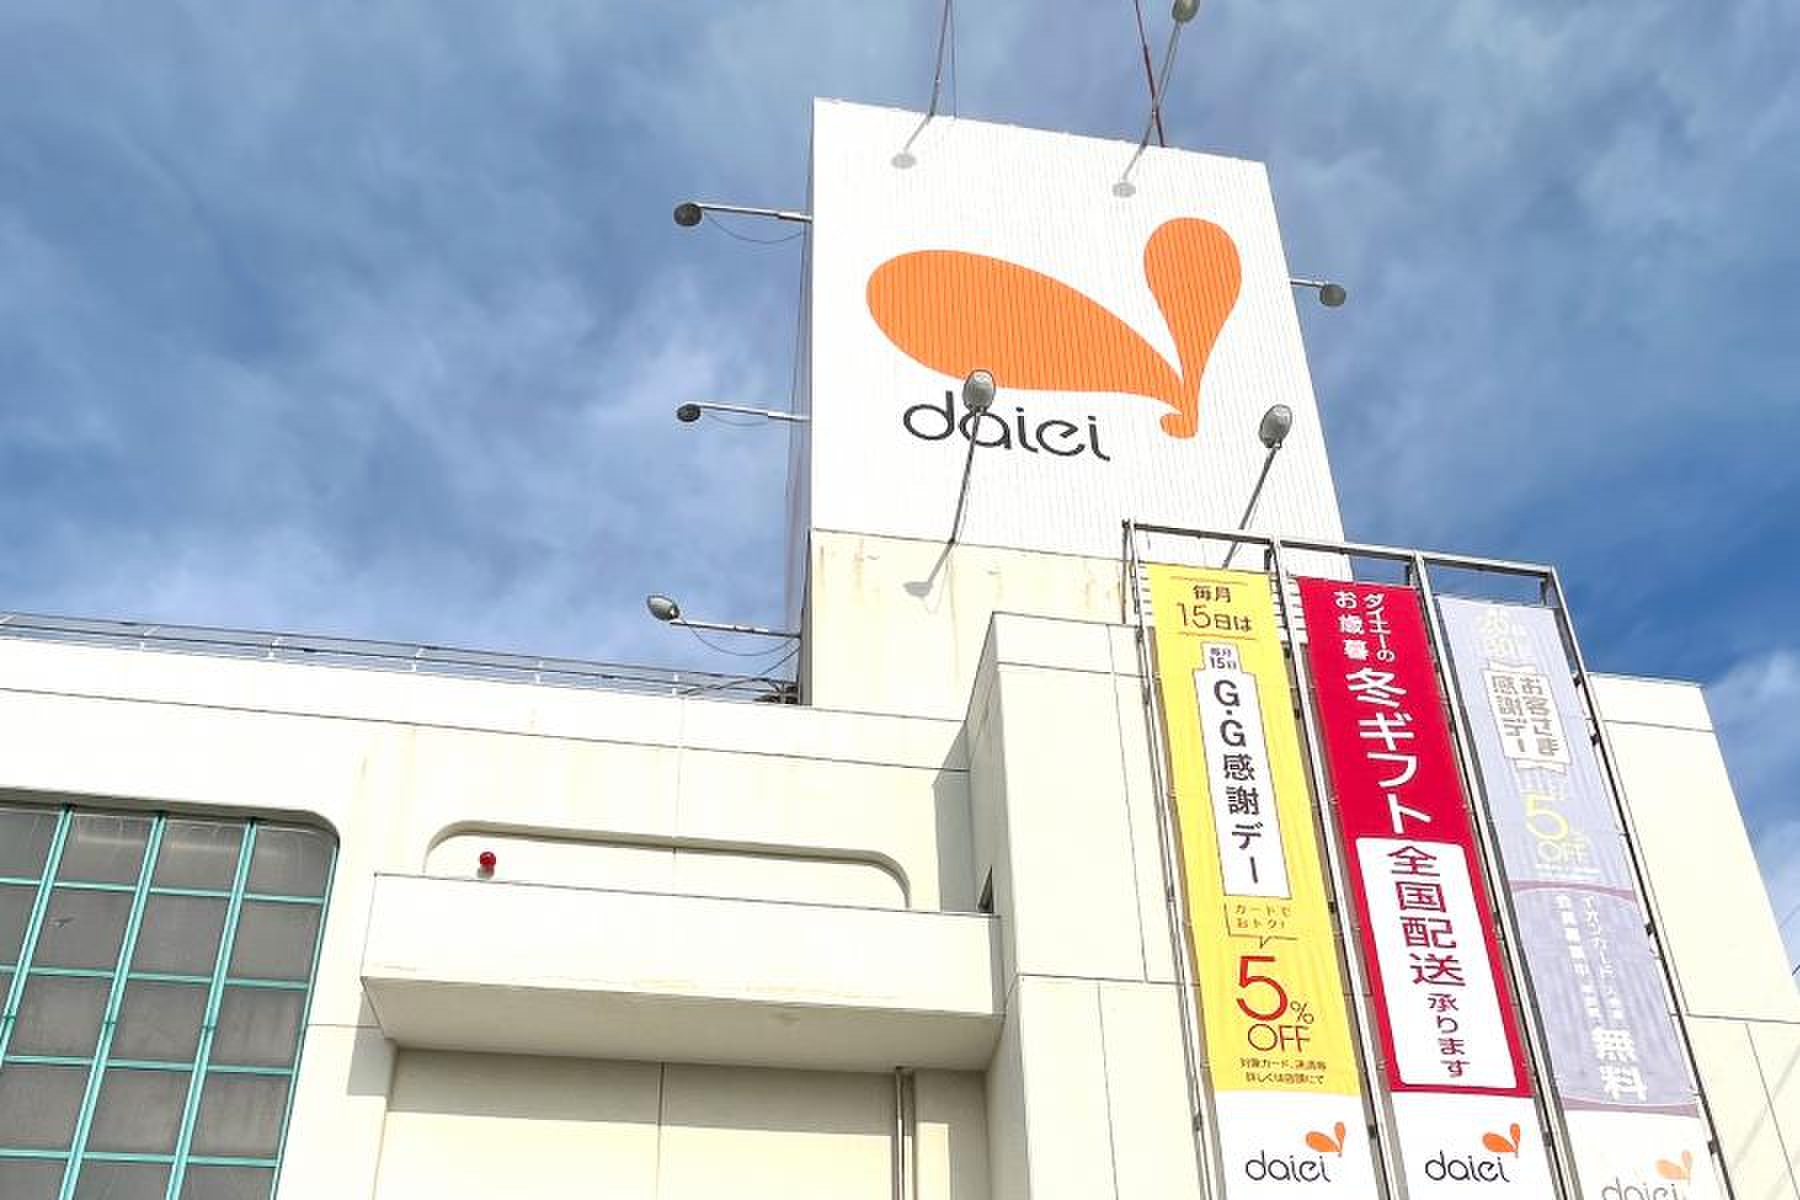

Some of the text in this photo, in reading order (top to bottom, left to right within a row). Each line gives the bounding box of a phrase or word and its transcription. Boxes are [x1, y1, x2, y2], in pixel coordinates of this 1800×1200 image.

[902, 389, 1111, 462] daiei
[1176, 602, 1253, 632] 15日は
[1193, 585, 1232, 603] 毎月
[1333, 590, 1370, 662] お歳暮
[1362, 592, 1396, 663] ダイエーの
[1344, 667, 1432, 834] 冬ギフト
[1235, 955, 1315, 1024] 5%
[1247, 1023, 1311, 1053] OFF
[1592, 1028, 1648, 1101] 無料
[1245, 1149, 1332, 1183] daiei
[1424, 1149, 1511, 1183] daiei
